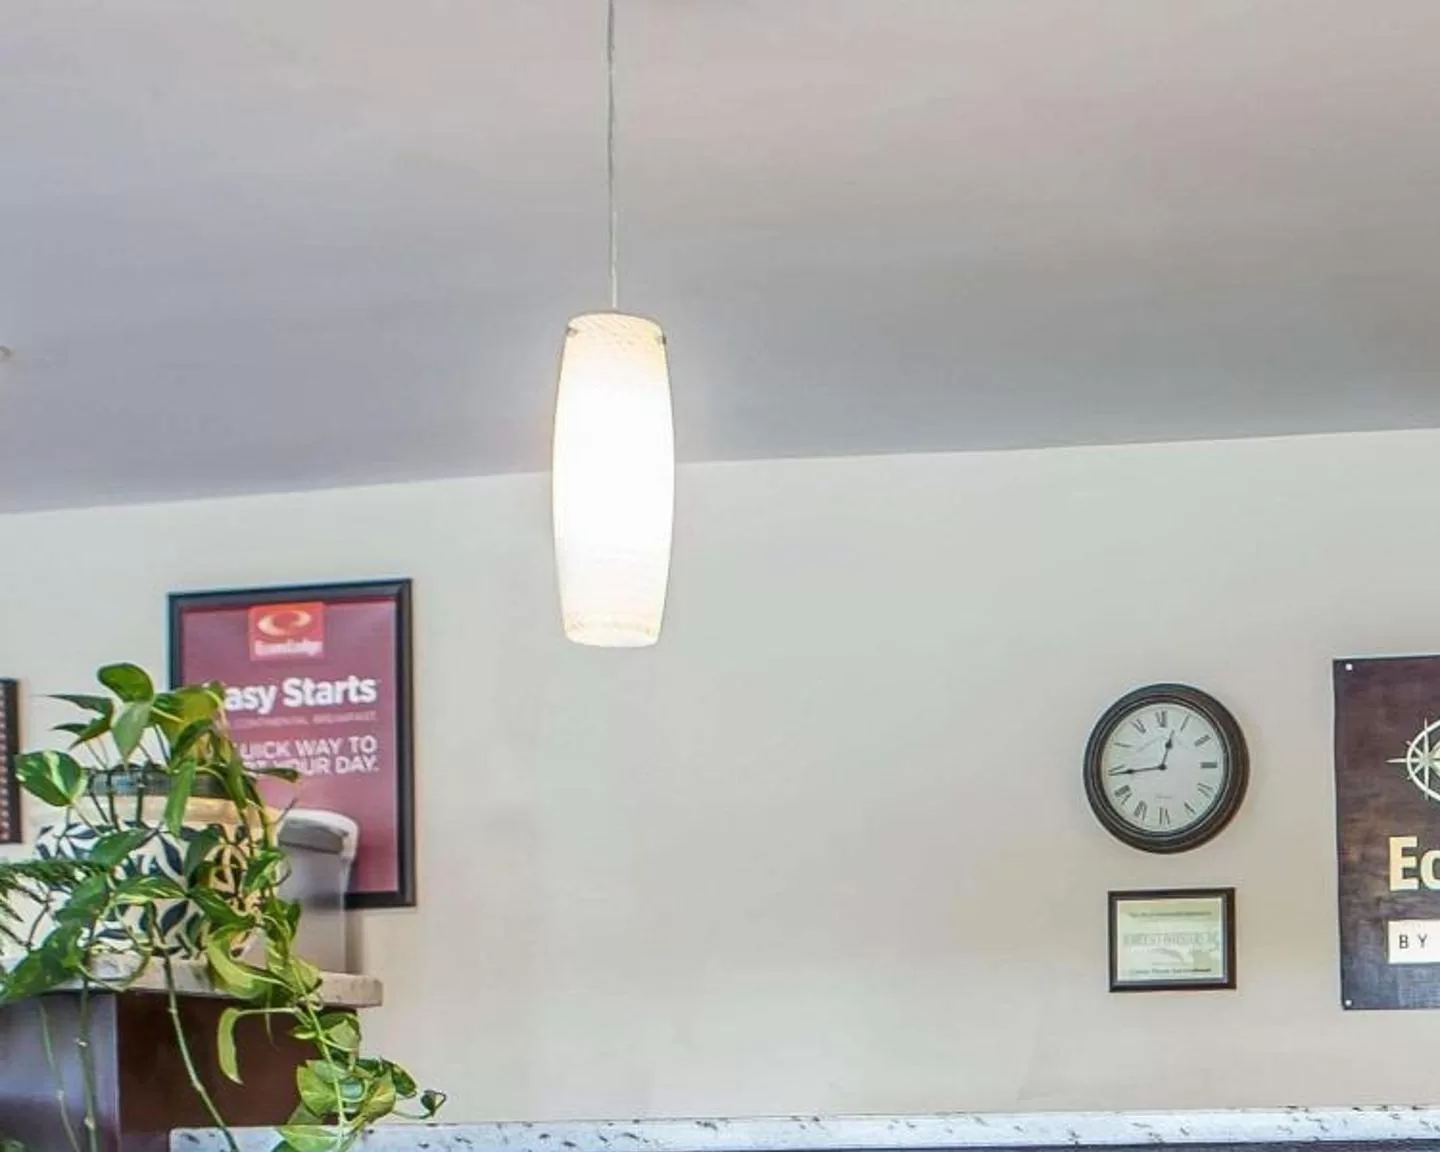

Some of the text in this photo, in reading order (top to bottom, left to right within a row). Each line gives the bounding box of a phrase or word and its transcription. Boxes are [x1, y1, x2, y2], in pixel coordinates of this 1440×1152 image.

[203, 675, 377, 715] asy Starts
[232, 734, 377, 760] UICK WAY TO
[1398, 934, 1428, 949] BY
